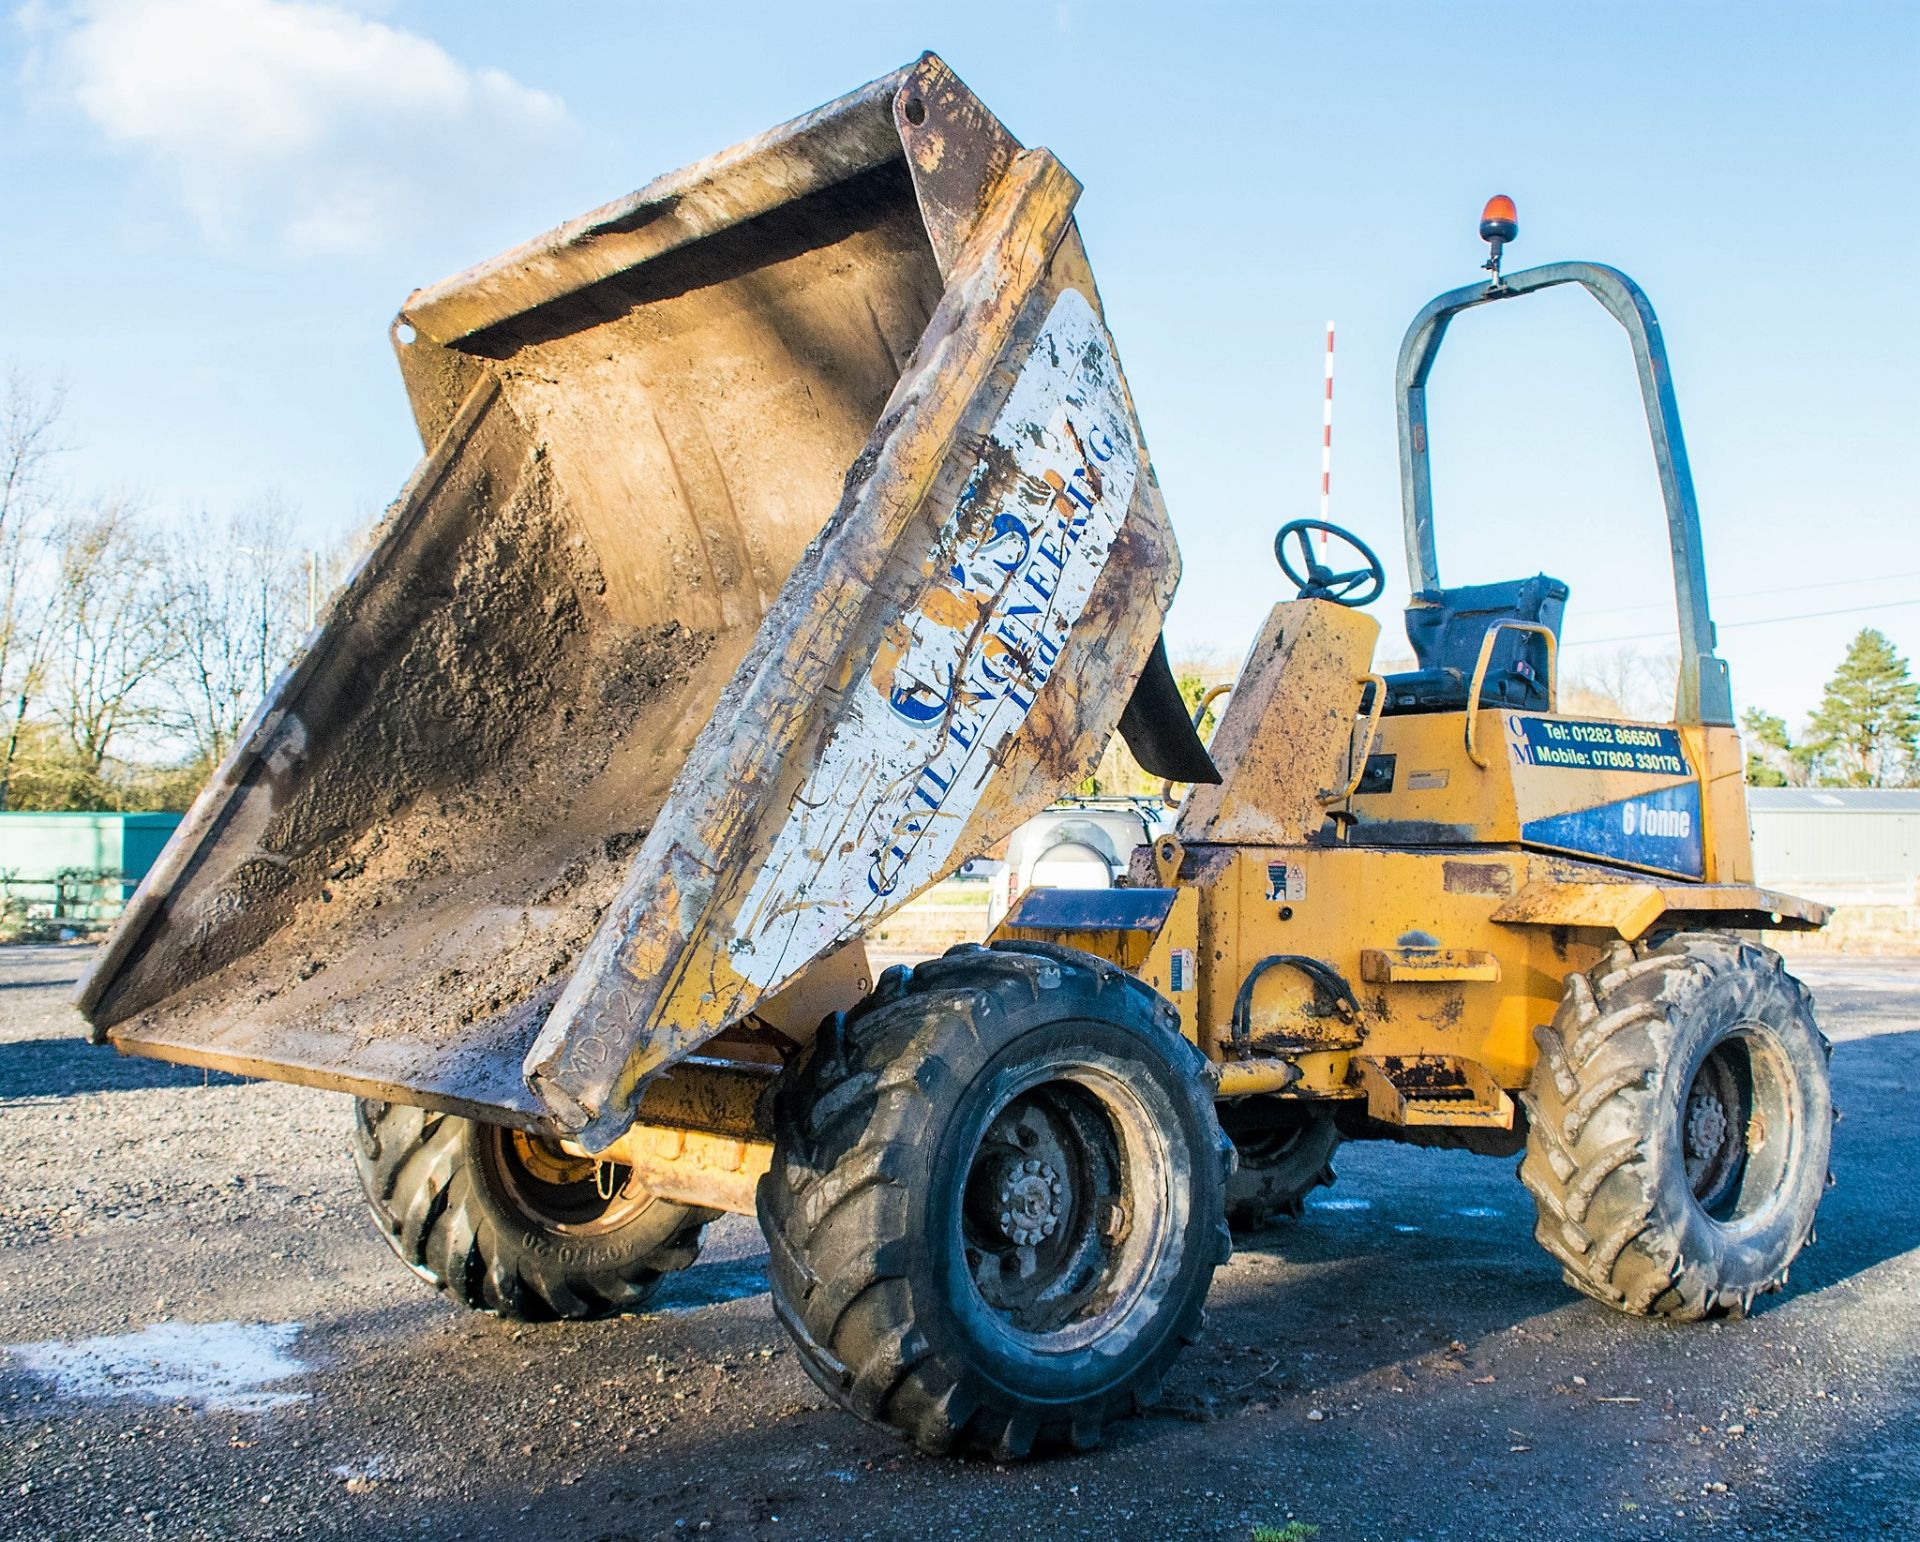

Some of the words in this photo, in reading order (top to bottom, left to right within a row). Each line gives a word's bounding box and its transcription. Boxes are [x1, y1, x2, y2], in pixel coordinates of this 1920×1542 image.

[1544, 723, 1570, 740] Tel:
[1572, 726, 1614, 744] 01282
[1615, 729, 1662, 747] 866501
[1536, 746, 1591, 765] Mobile:
[1592, 751, 1635, 768] 07808
[1637, 753, 1681, 772] 330176
[1622, 802, 1635, 835] 6
[1640, 803, 1690, 838] tonne
